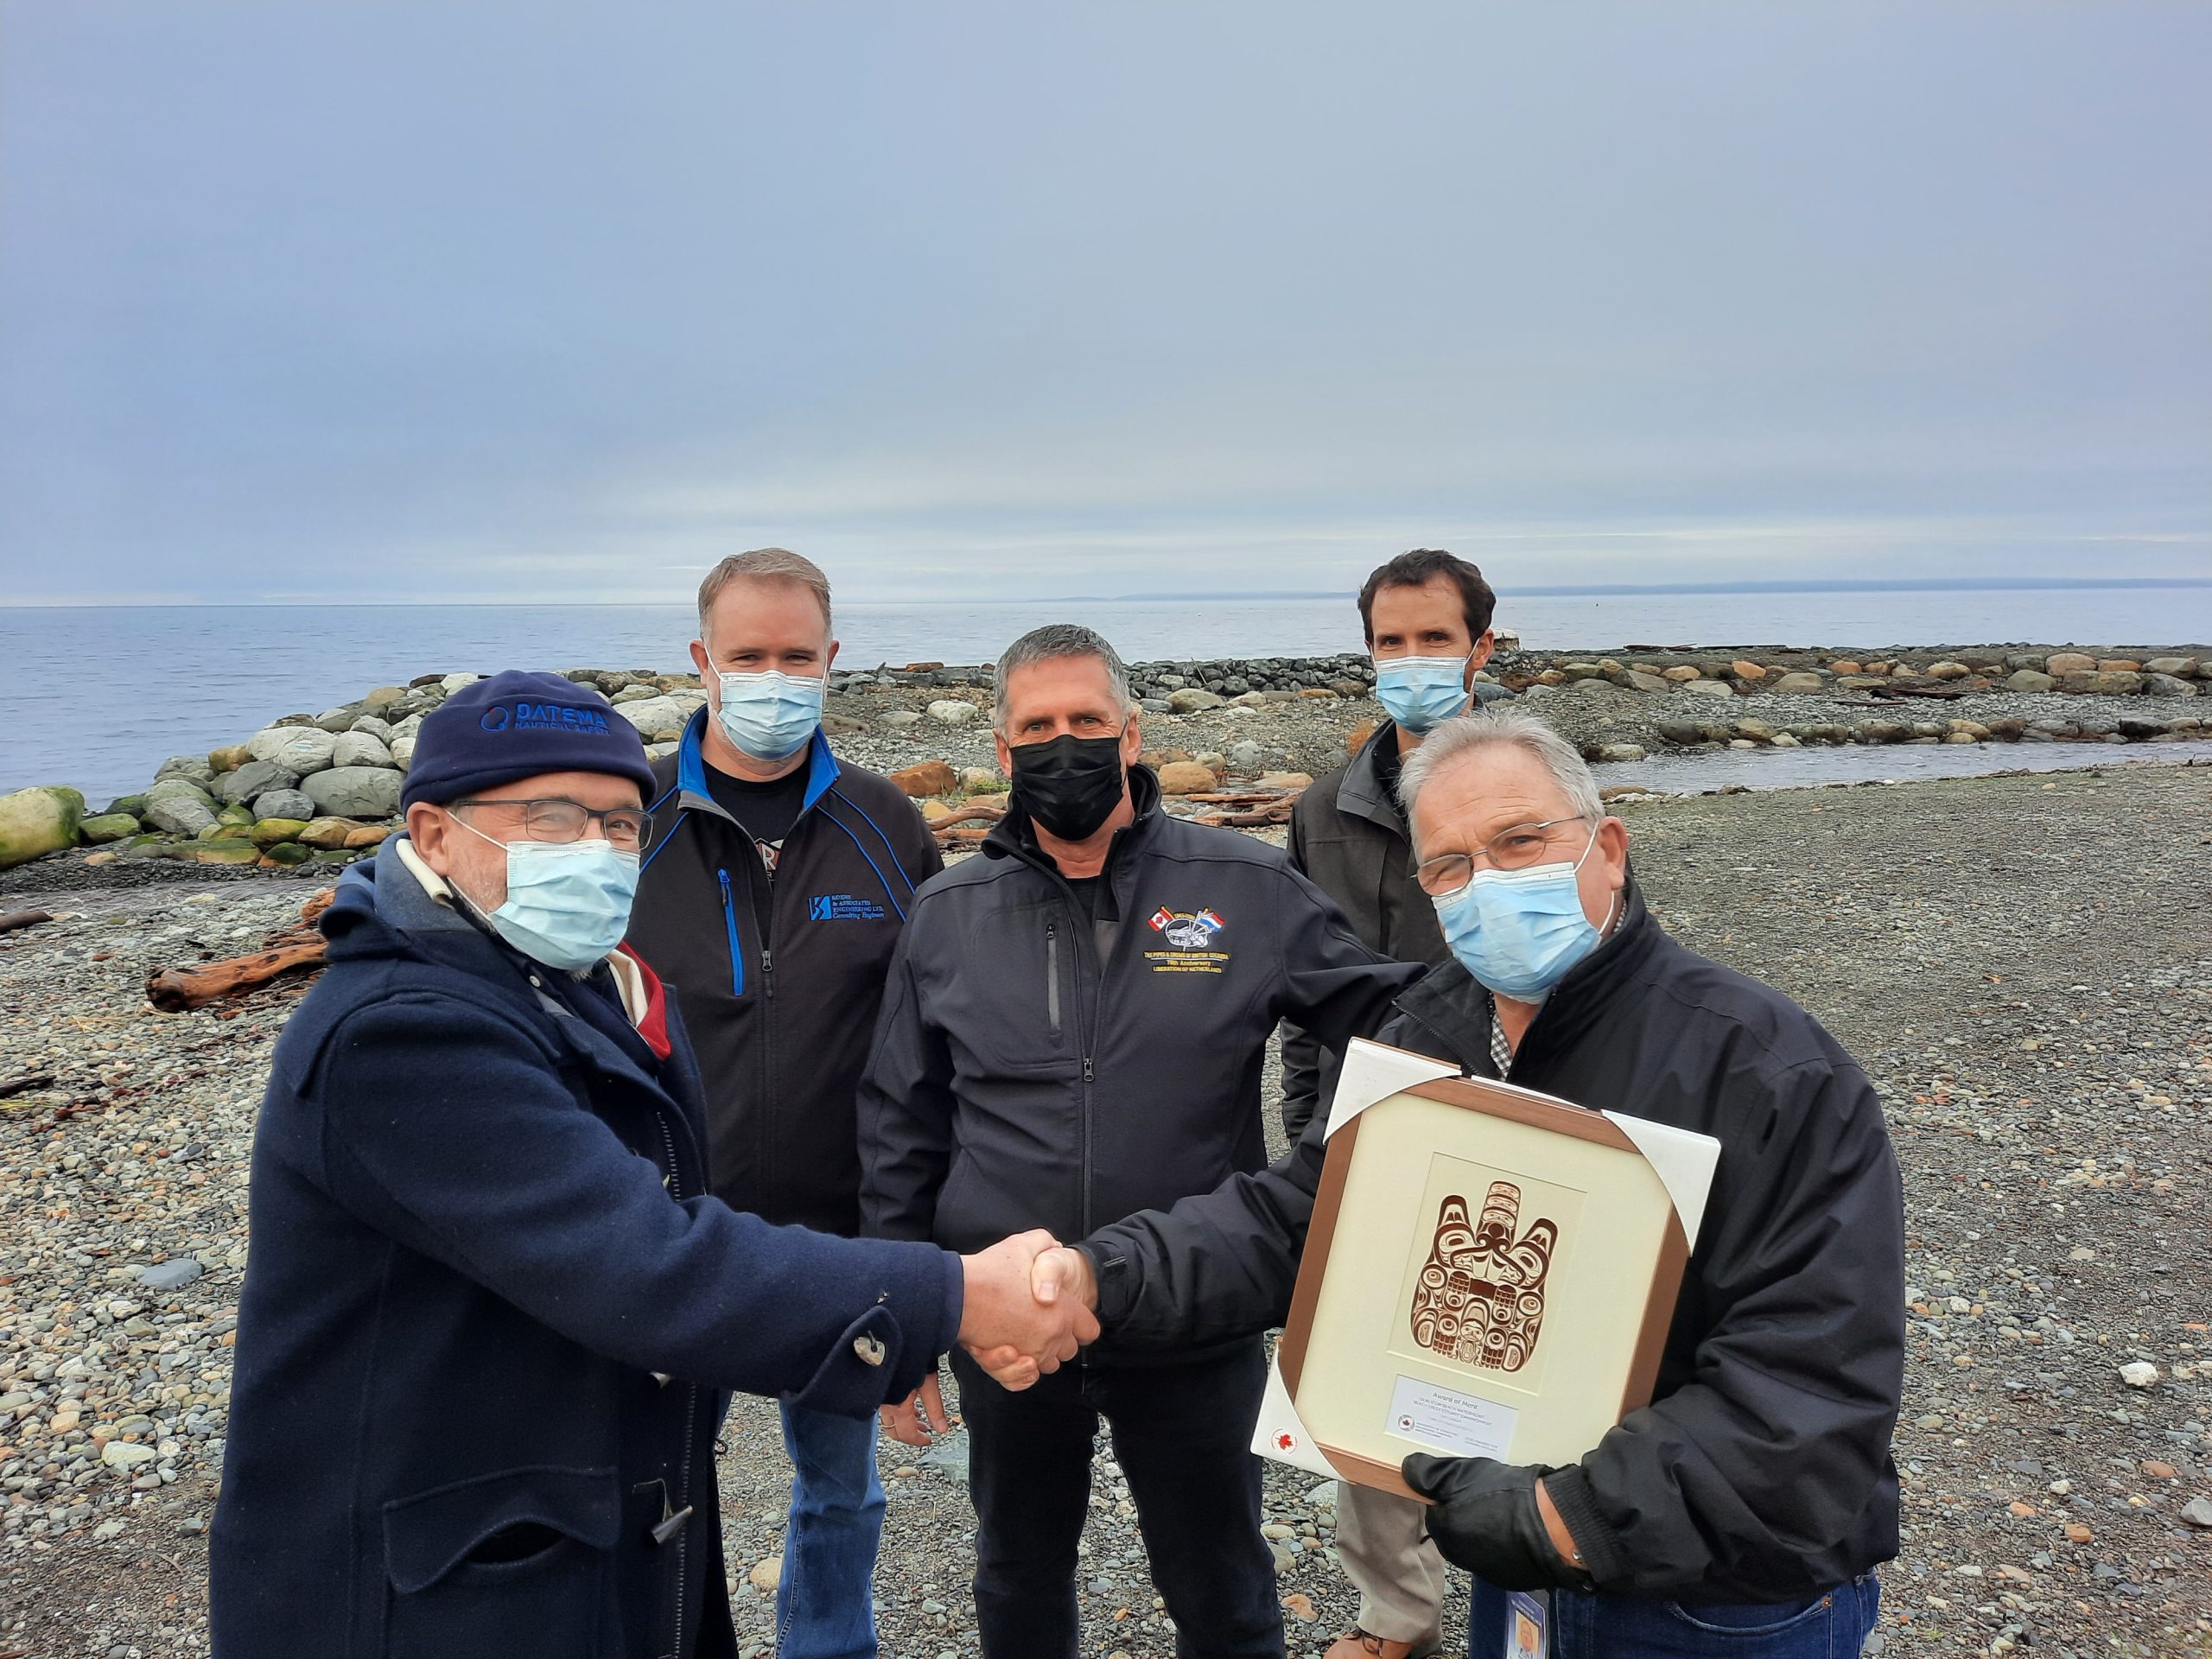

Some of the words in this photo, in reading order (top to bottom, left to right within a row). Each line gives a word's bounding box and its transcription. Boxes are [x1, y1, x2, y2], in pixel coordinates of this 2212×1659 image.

[516, 703, 608, 727] DATEMA
[515, 721, 572, 730] NAUTICAL
[1433, 1392, 1453, 1403] Award
[1462, 1401, 1478, 1410] Merit
